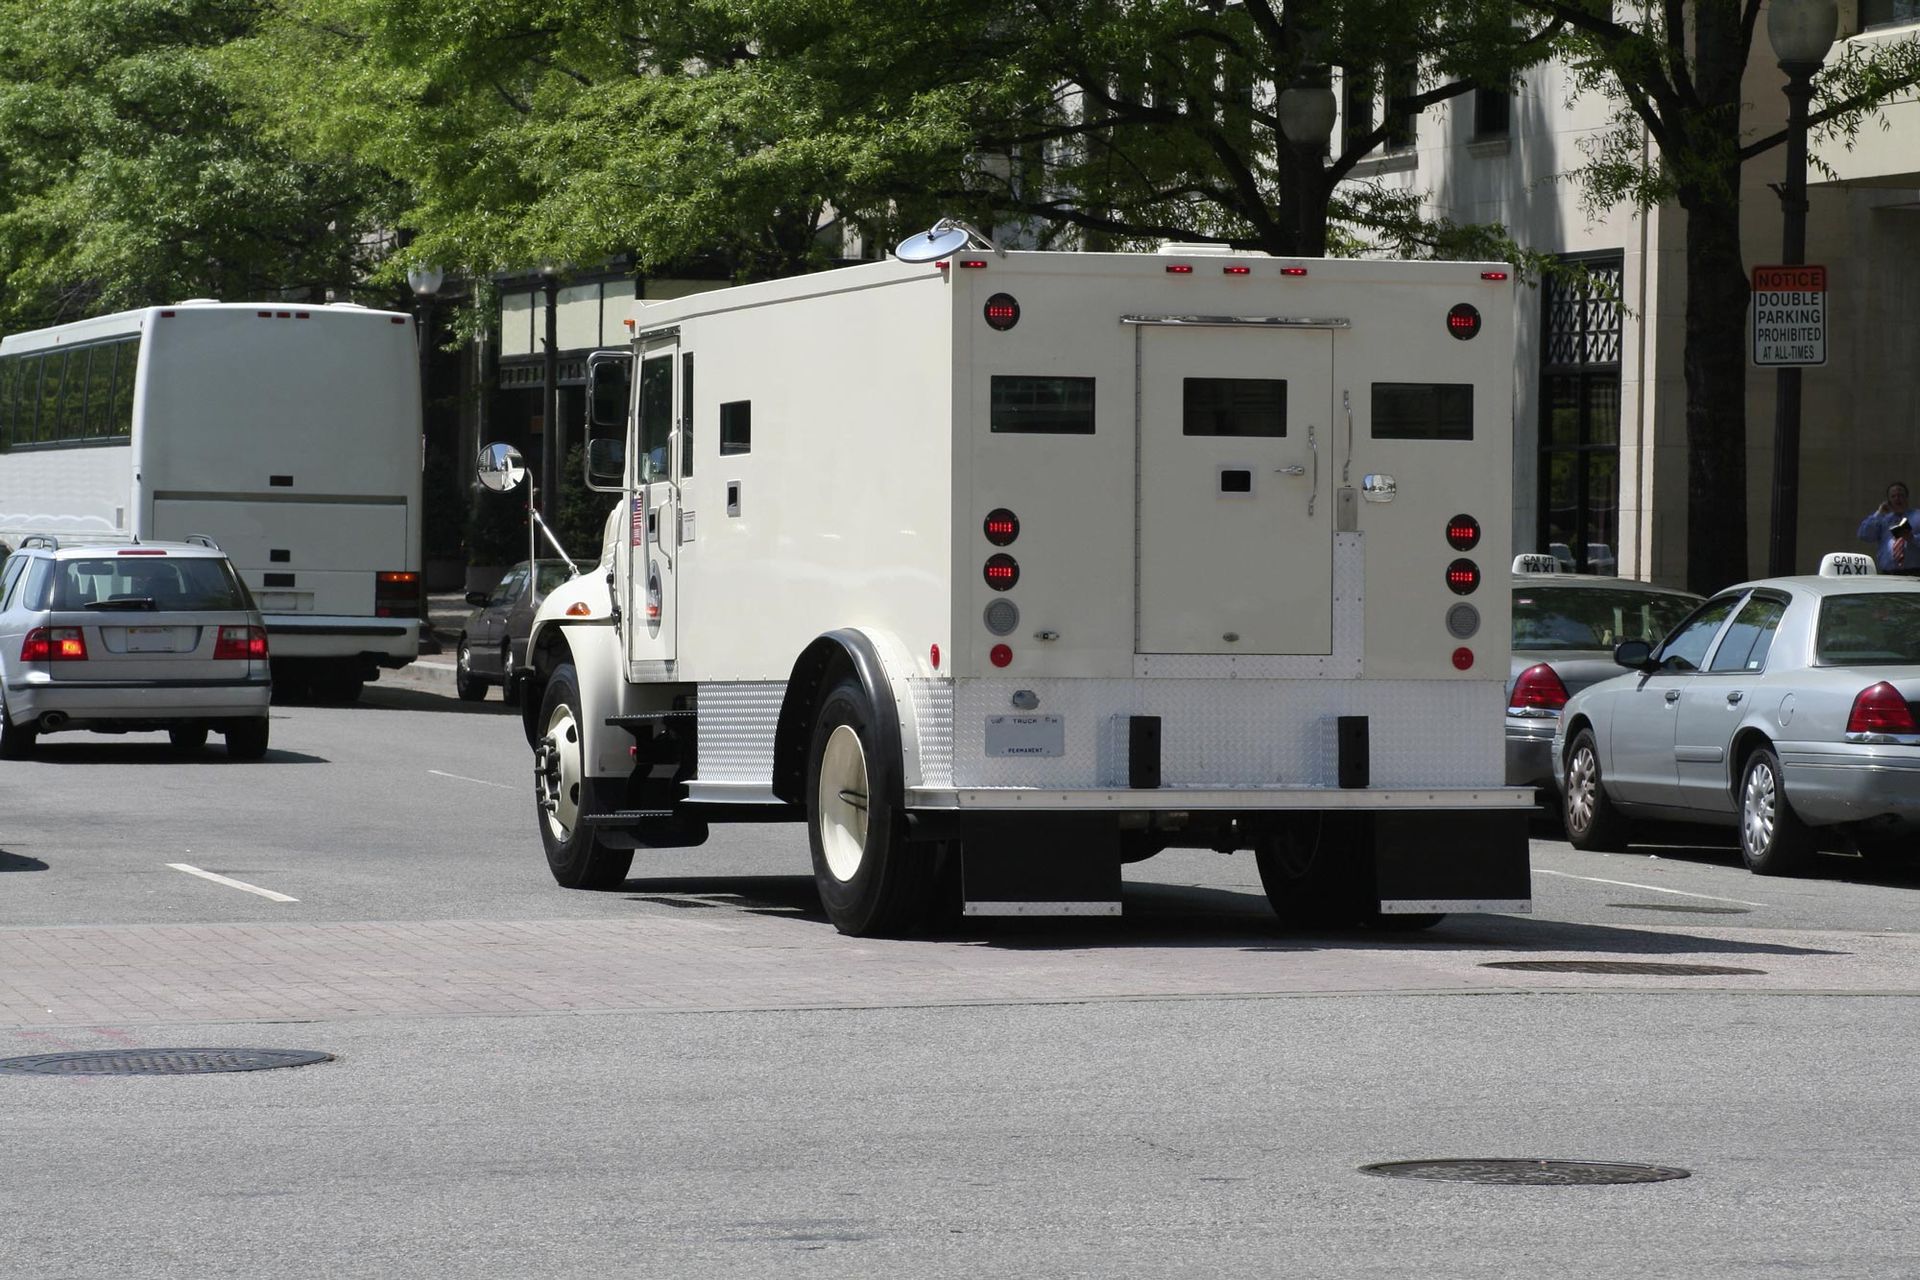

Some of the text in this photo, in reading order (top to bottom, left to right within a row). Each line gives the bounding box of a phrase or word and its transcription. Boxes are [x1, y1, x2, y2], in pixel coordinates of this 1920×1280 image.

[1758, 271, 1821, 287] NOTICE
[1759, 292, 1820, 307] DOUBLE
[1758, 309, 1821, 324] PARKING
[1758, 327, 1822, 342] PROHIBITED
[1763, 346, 1772, 360] AT
[1523, 562, 1555, 573] TAXI
[1854, 556, 1867, 565] 911
[1833, 564, 1867, 575] TAXI
